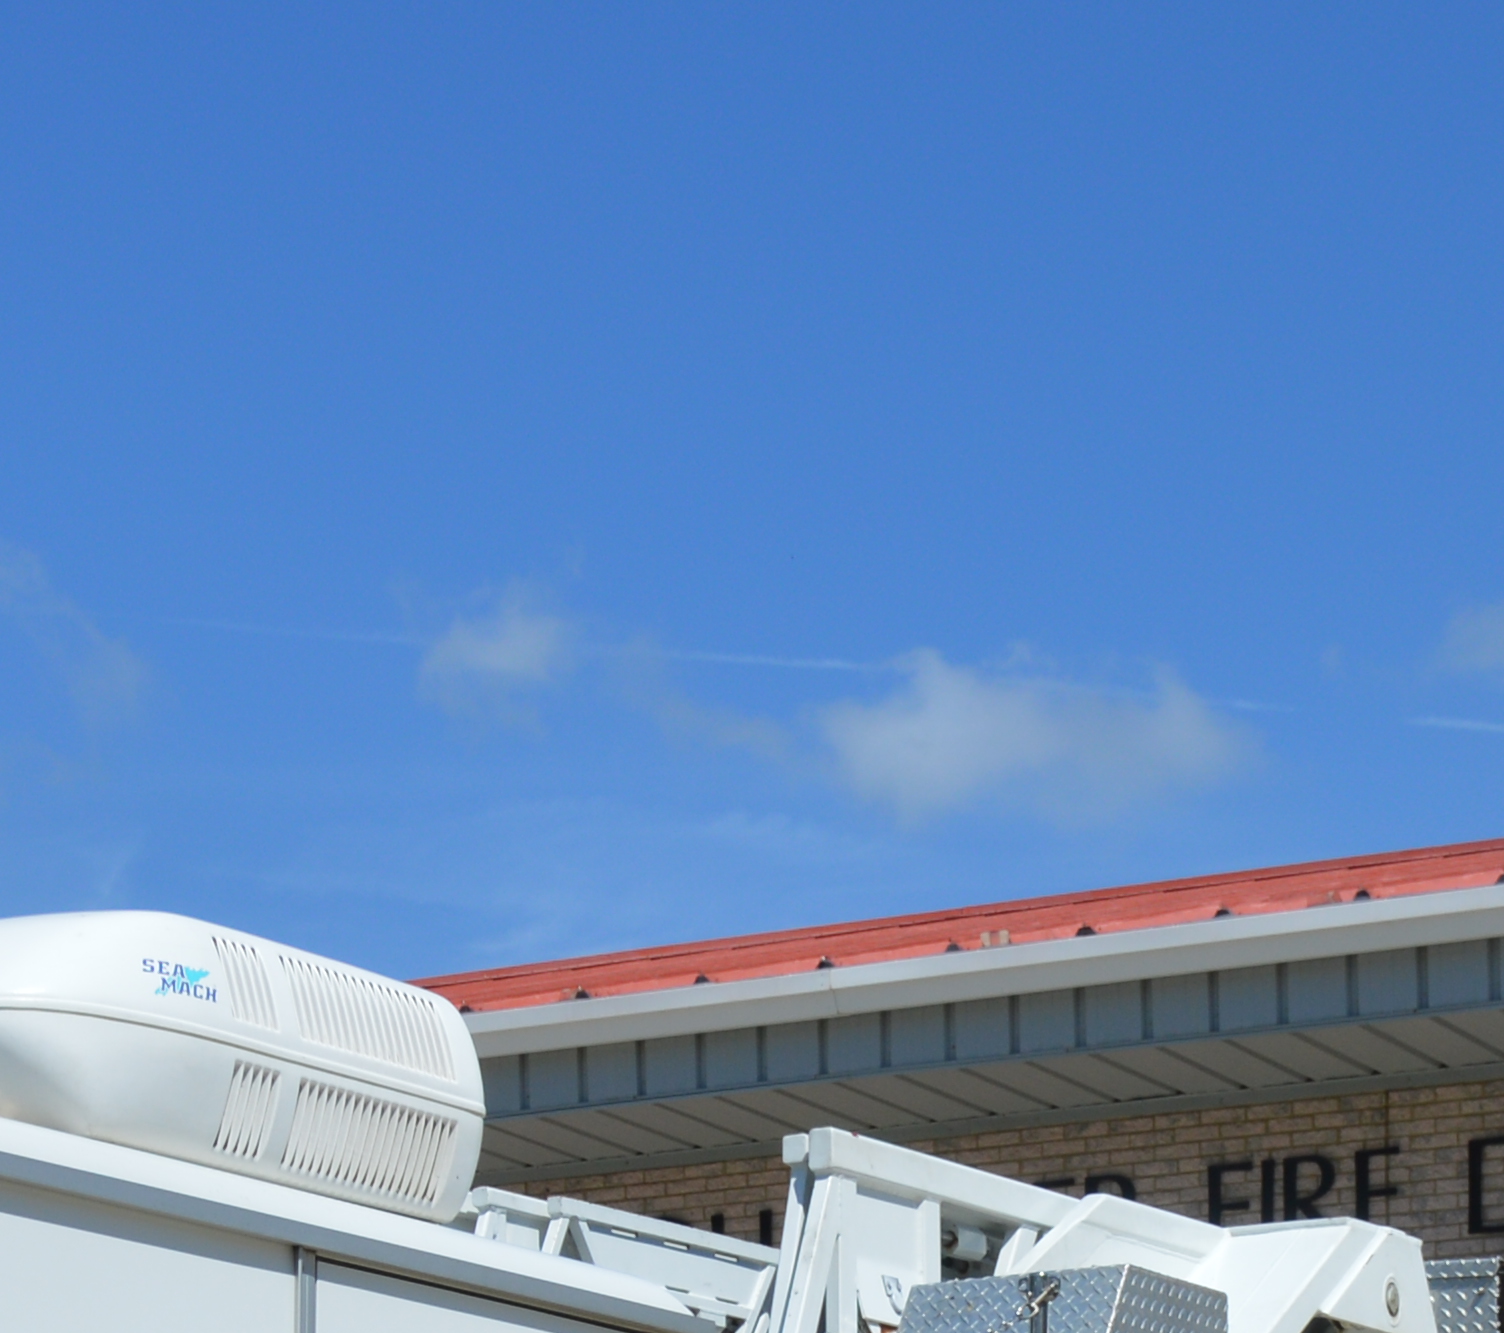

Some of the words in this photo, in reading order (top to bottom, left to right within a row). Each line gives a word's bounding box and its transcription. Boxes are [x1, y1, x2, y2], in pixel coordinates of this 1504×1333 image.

[142, 958, 185, 978] SEA
[161, 977, 217, 1003] MACH
[1206, 1144, 1402, 1224] FIRE
